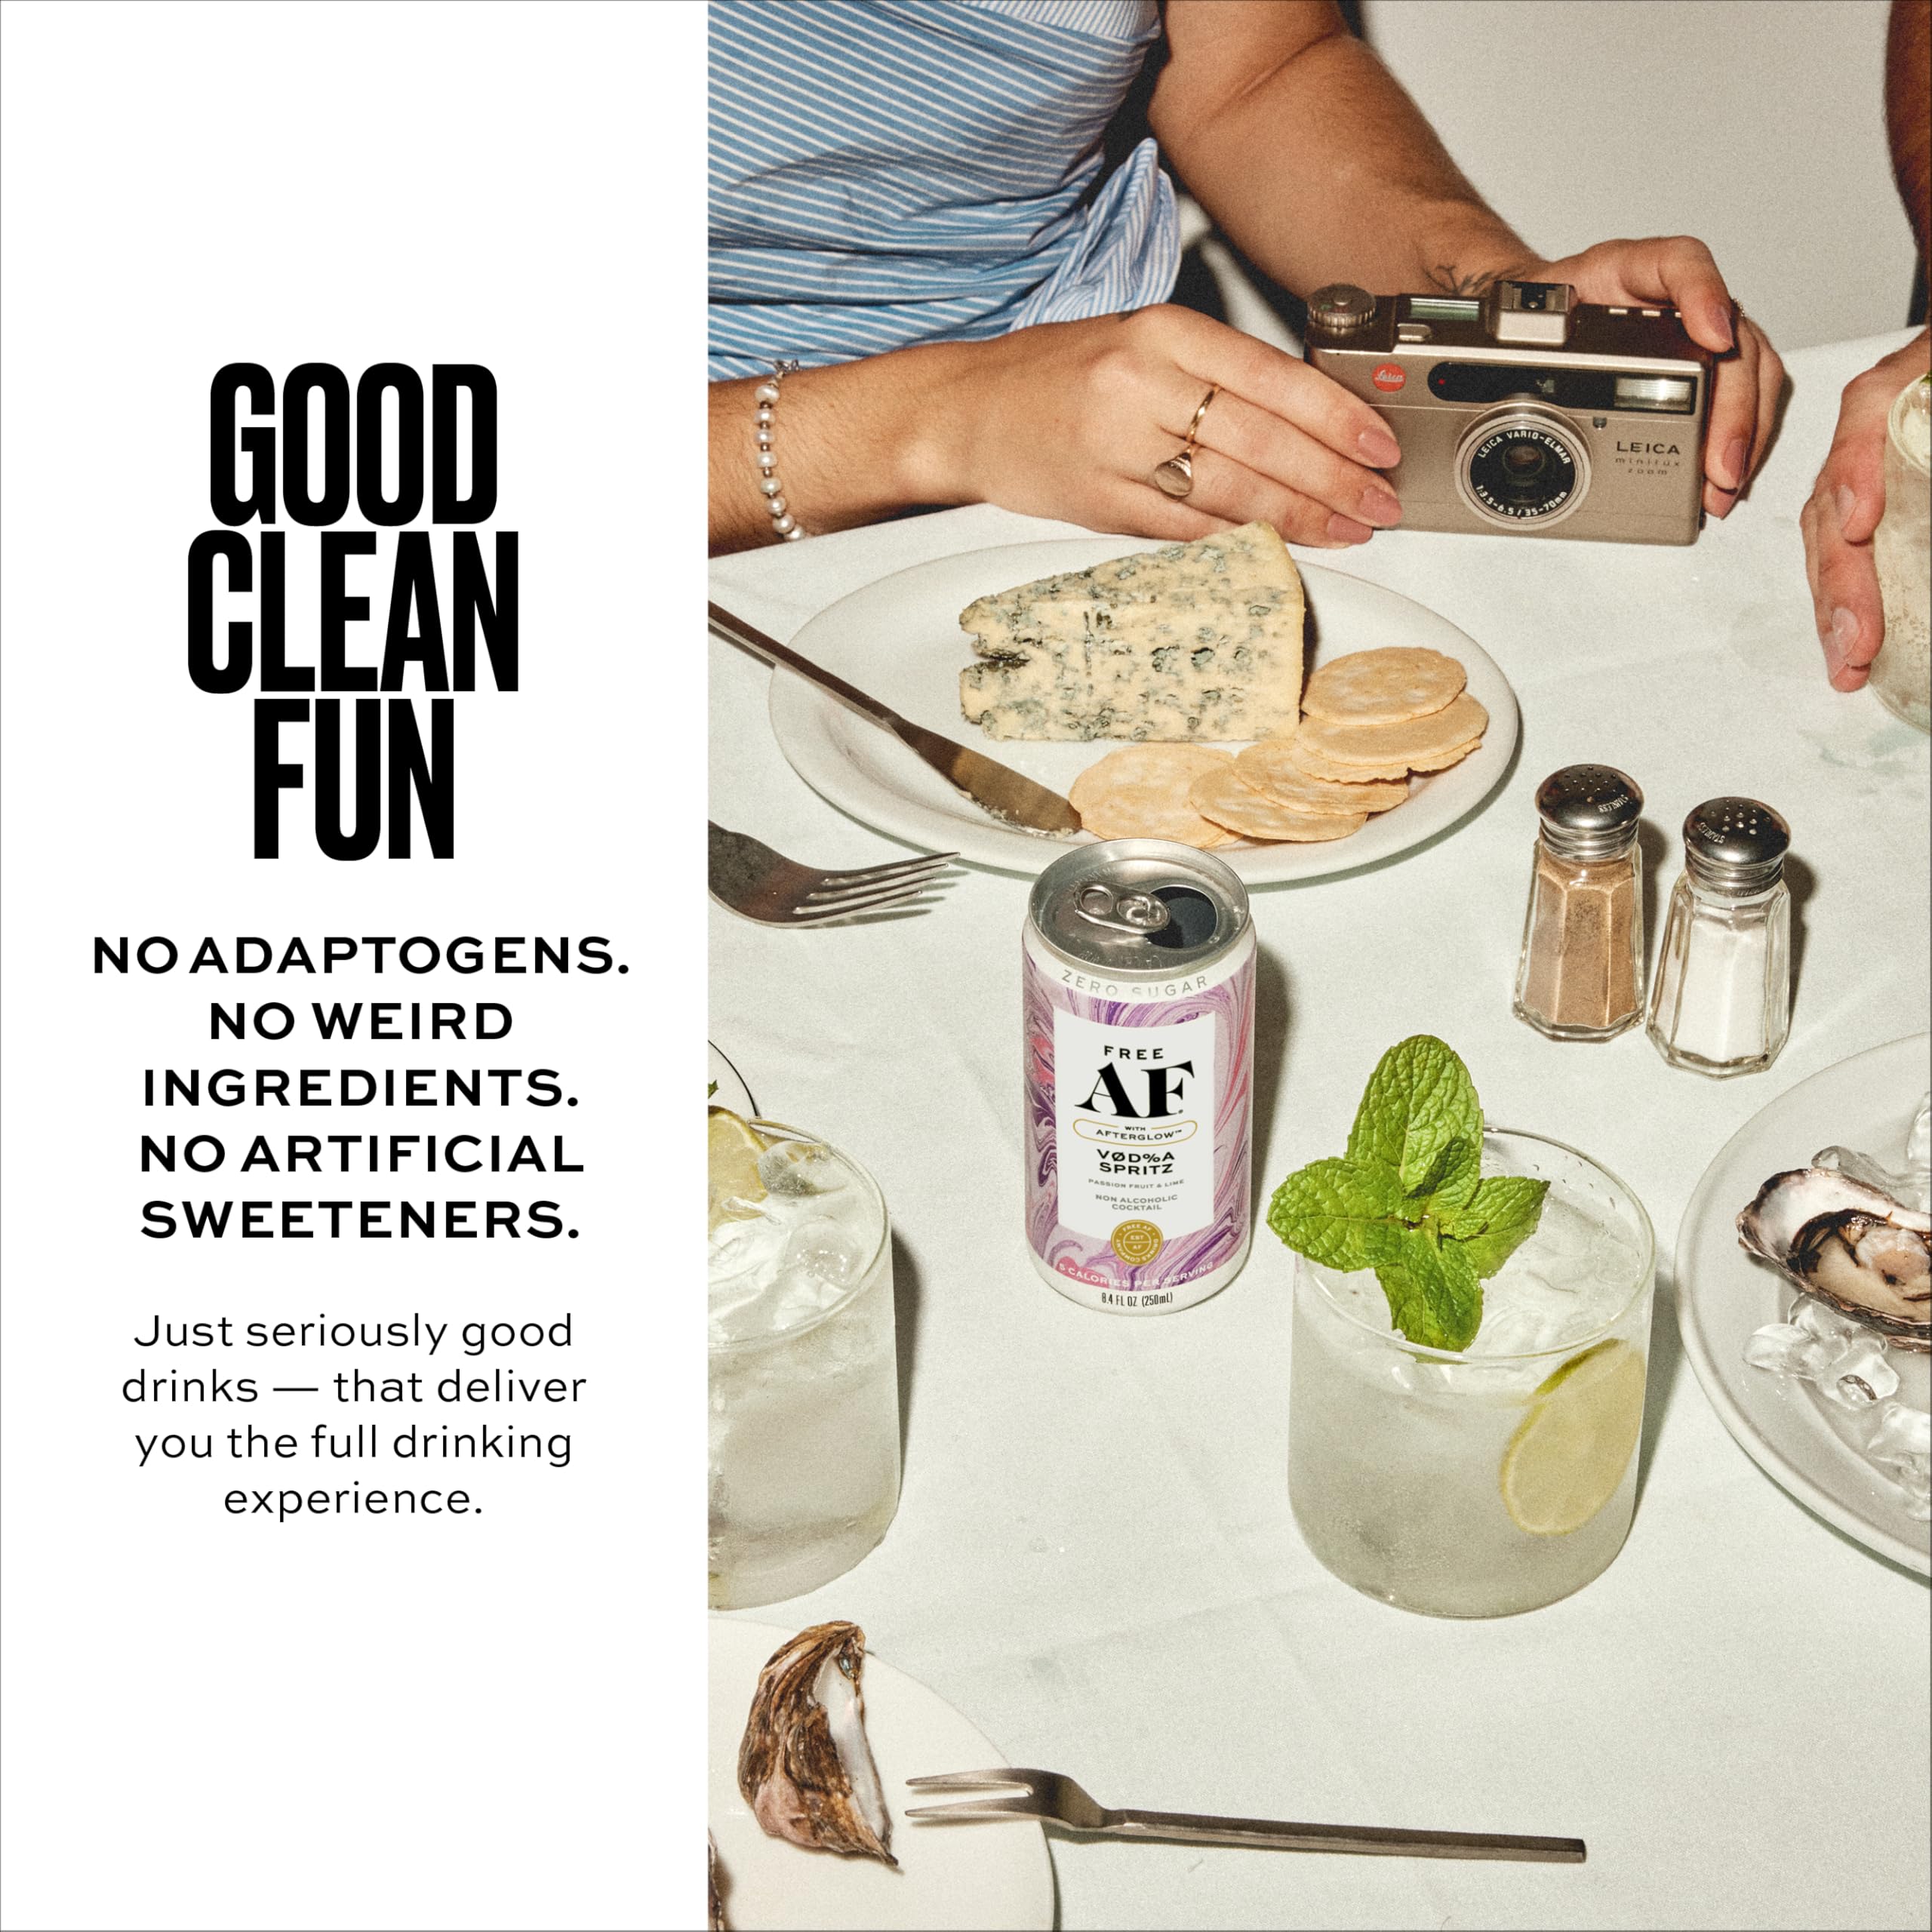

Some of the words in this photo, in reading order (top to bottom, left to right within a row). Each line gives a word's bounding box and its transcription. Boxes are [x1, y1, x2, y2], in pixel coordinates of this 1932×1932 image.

[1477, 435, 1503, 458] LEICA
[1506, 430, 1571, 464] VARIO-ELMAR
[1617, 441, 1680, 455] LEICA
[1524, 491, 1568, 517] 35-70mm
[1061, 969, 1118, 997] ZERO
[1132, 975, 1208, 998] SUGAR
[1104, 1045, 1164, 1060] FREE
[1097, 1148, 1175, 1163] VØD%A
[1099, 1161, 1174, 1175] SPRITZ
[1088, 1178, 1126, 1189] PASSION
[1164, 1178, 1185, 1187] LIME
[1095, 1194, 1117, 1202] NON
[1120, 1194, 1178, 1204] ALCOHOLIC
[1068, 1267, 1128, 1287] CALORIES
[1164, 1261, 1214, 1283] SERVING
[1101, 1291, 1113, 1305] 8.4
[1116, 1295, 1125, 1306] FL
[1128, 1296, 1138, 1307] OZ
[1141, 1292, 1174, 1307] (250mL)
